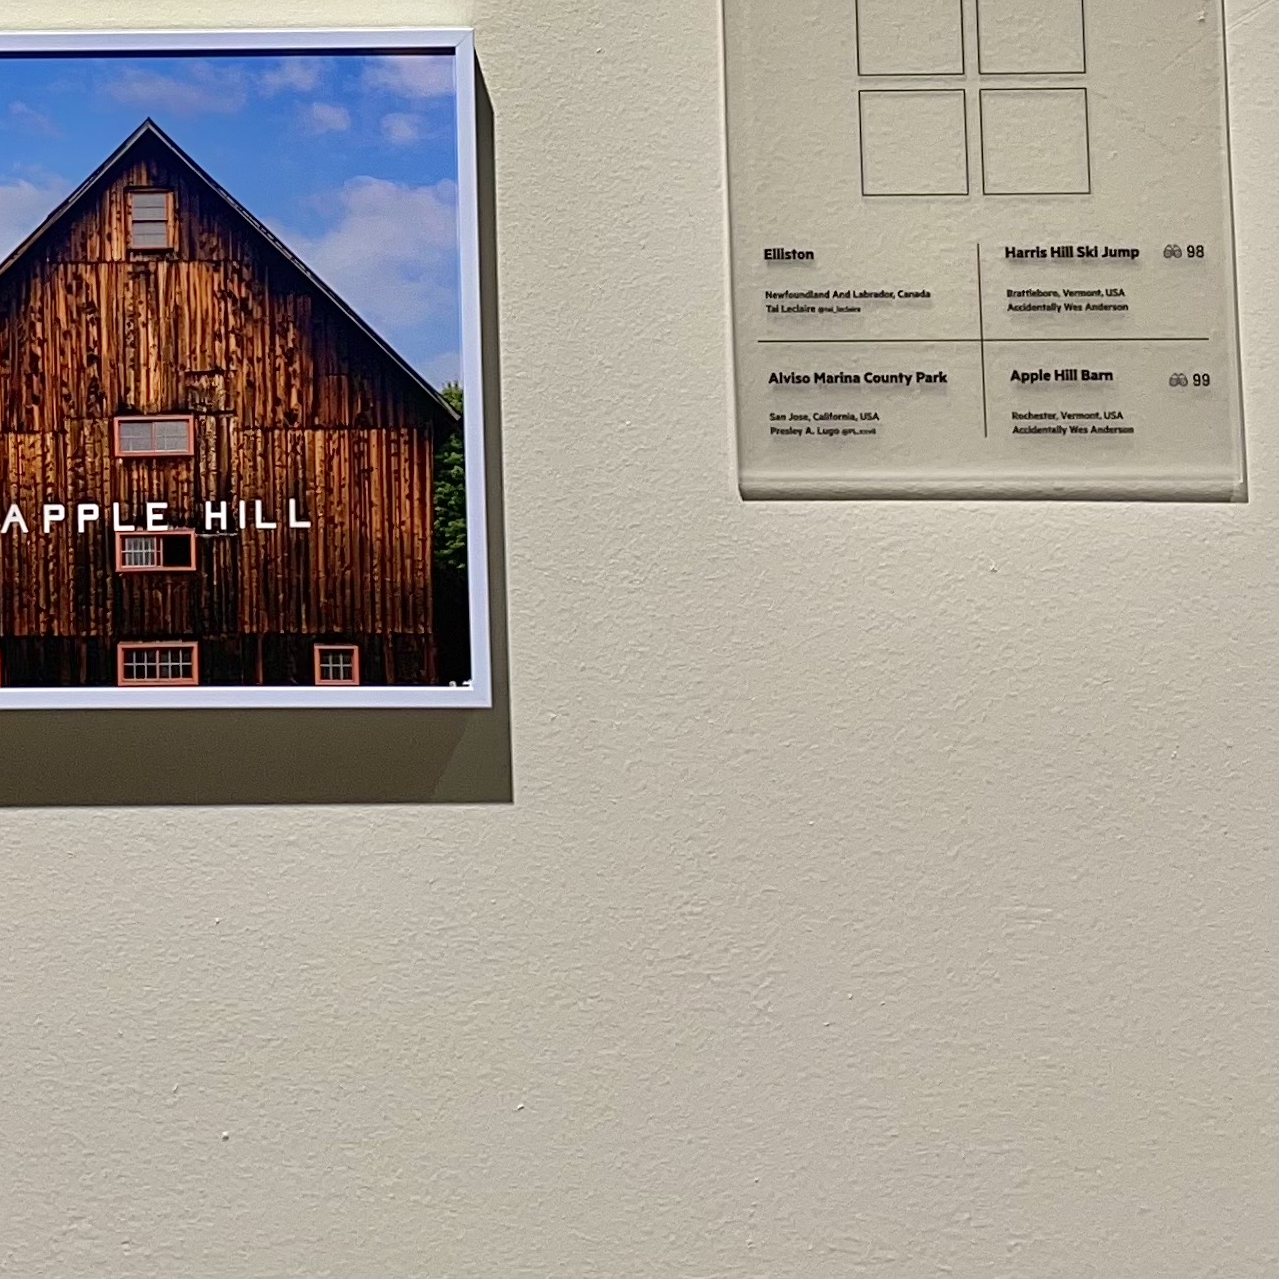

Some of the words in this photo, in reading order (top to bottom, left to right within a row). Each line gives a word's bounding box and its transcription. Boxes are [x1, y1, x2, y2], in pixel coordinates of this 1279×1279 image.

[764, 248, 814, 260] Elliston
[1005, 246, 1047, 258] Harris
[1050, 246, 1073, 258] Hill
[1077, 246, 1098, 258] Ski
[1102, 246, 1139, 260] Jump
[1186, 245, 1204, 258] 98
[765, 290, 830, 299] Newfoundland
[832, 290, 850, 298] And
[853, 290, 895, 300] Labrador,
[897, 290, 931, 298] Canada
[1006, 289, 1060, 298] Brattleboro,
[1062, 289, 1104, 298] Vermont,
[1106, 289, 1125, 297] USA
[766, 305, 779, 313] Tai
[781, 305, 815, 313] Leclaire
[1007, 303, 1061, 312] Accidentally
[1064, 303, 1082, 311] Wes
[1085, 303, 1128, 311] Anderson
[769, 372, 810, 384] Alviso
[814, 372, 860, 384] Marina
[864, 372, 912, 386] County
[916, 371, 947, 383] Park
[1011, 370, 1051, 383] Apple
[1054, 370, 1077, 381] Hill
[1081, 370, 1113, 381] Barn
[1193, 373, 1210, 386] 99
[769, 413, 786, 421] San
[788, 413, 811, 422] Jose,
[813, 413, 858, 422] California,
[860, 413, 880, 421] USA
[1011, 412, 1058, 420] Rochester,
[1061, 412, 1102, 420] Vermont,
[770, 427, 802, 436] Presley
[805, 427, 814, 435] A.
[817, 427, 839, 436] Lugo
[1012, 426, 1067, 435] Accidentally
[1069, 426, 1088, 434] Wes
[1, 502, 168, 534] APPLE
[205, 498, 311, 530] HILL
